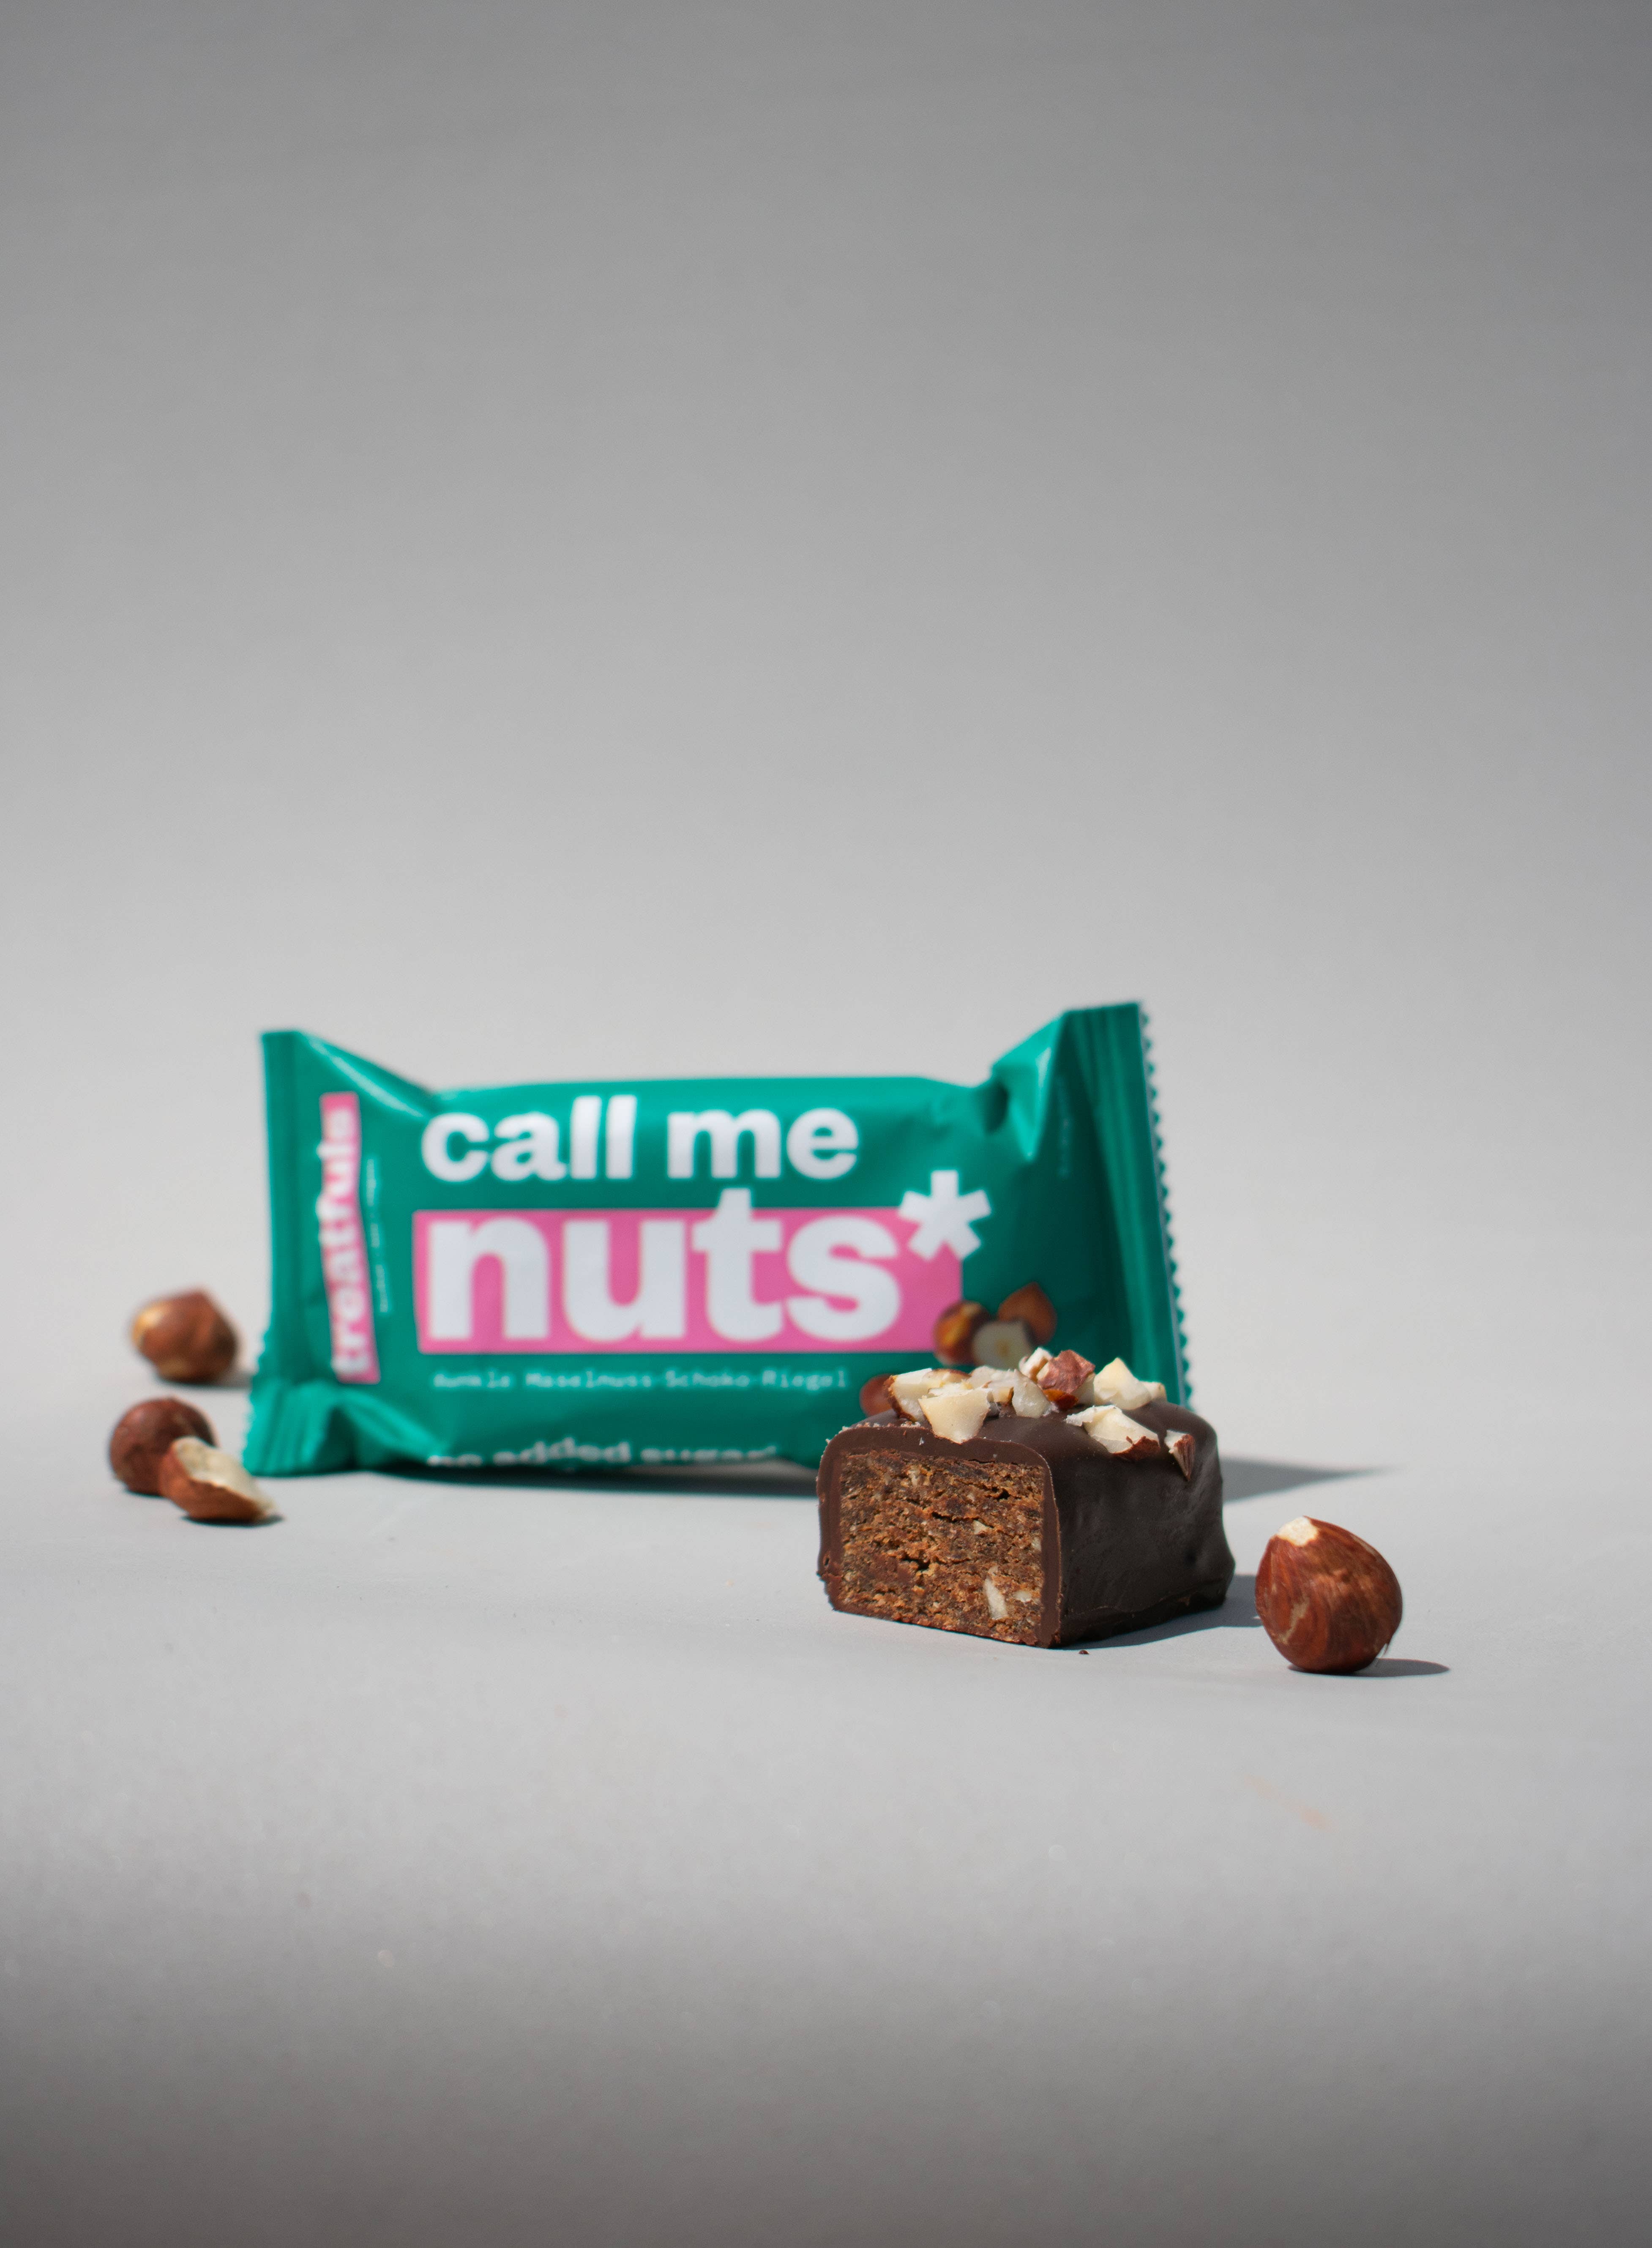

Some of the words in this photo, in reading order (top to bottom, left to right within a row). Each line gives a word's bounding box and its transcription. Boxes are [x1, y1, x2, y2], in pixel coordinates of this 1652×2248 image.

[421, 1095, 637, 1182] call
[667, 1108, 858, 1180] me
[492, 1436, 632, 1464] added
